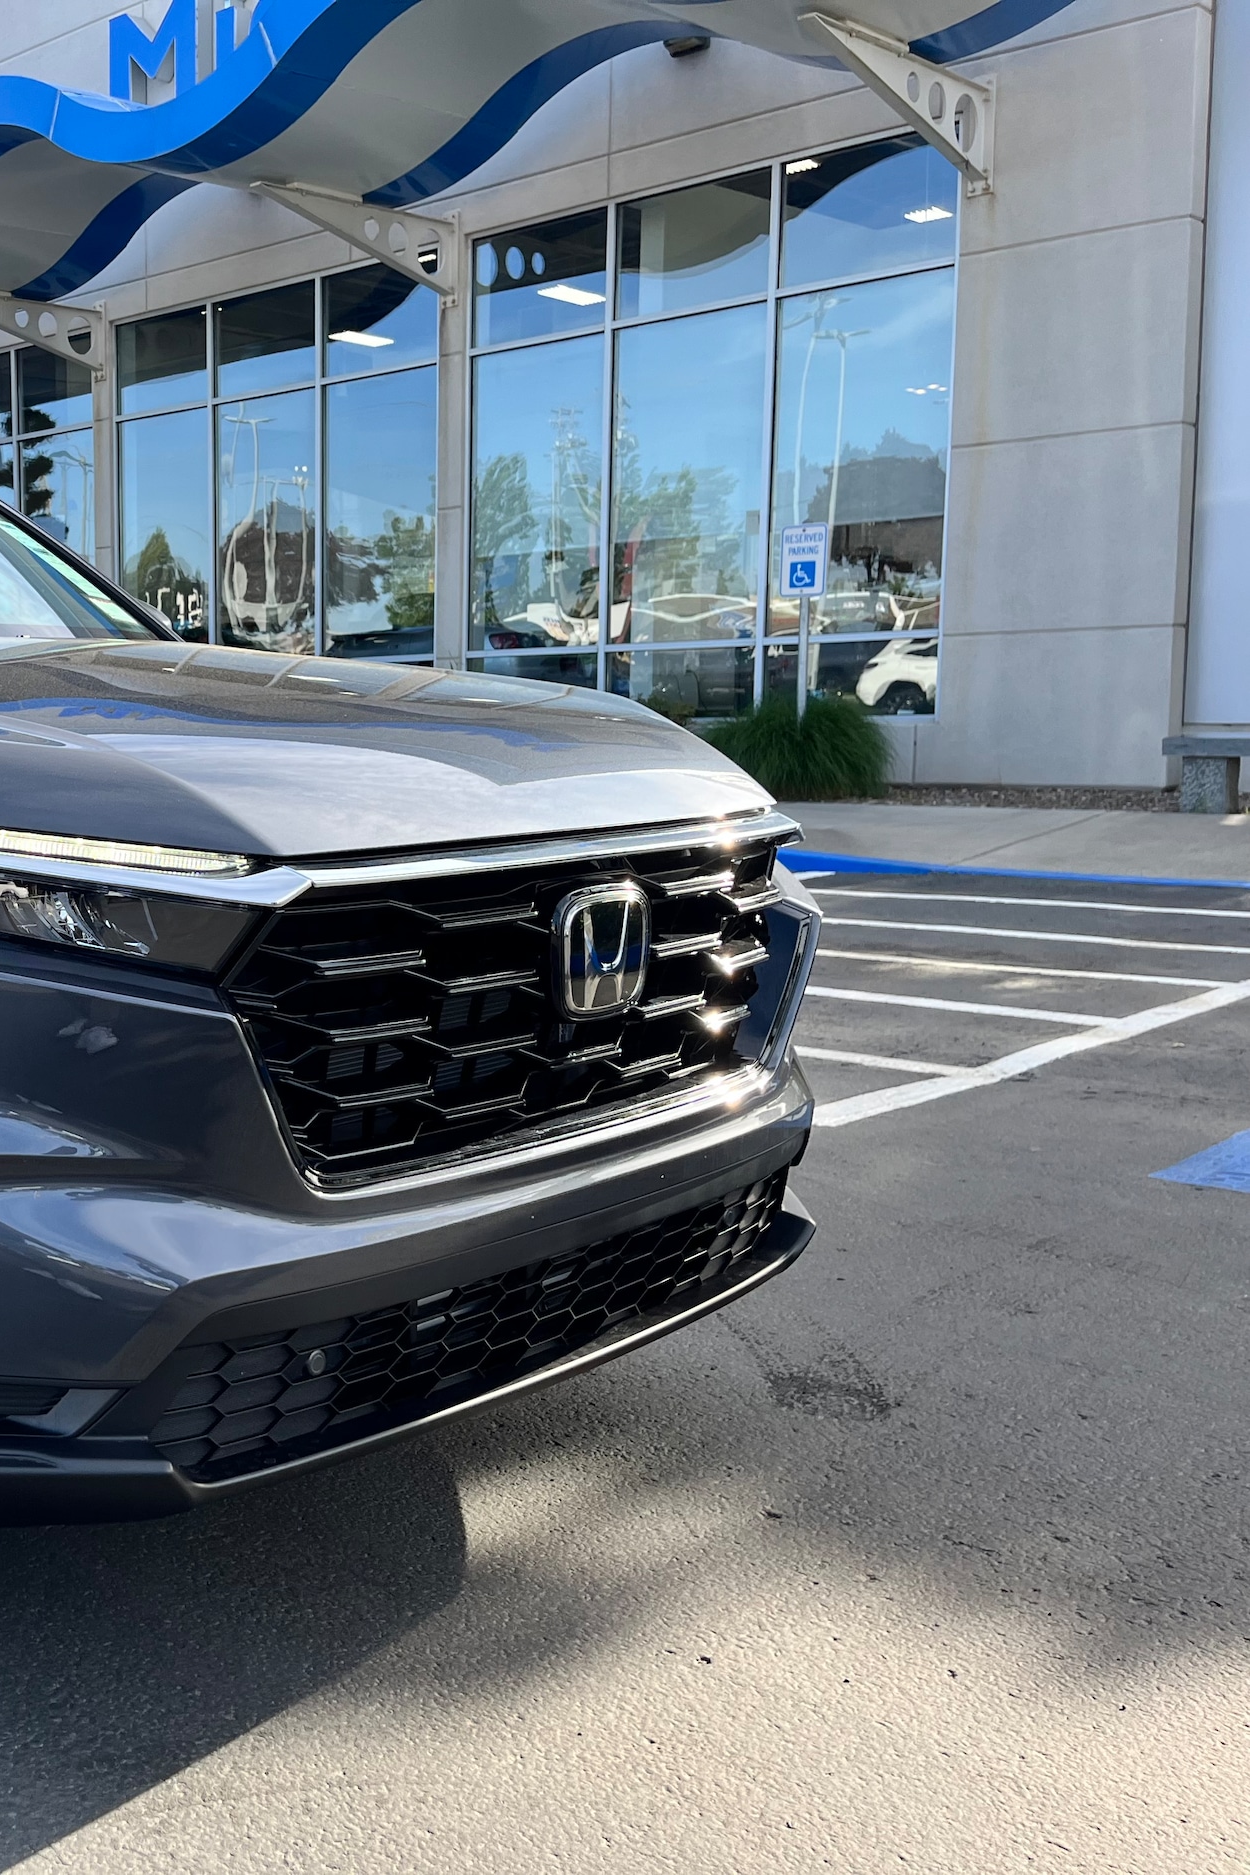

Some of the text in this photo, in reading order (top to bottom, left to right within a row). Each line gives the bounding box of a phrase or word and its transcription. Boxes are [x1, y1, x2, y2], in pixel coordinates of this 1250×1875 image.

[109, 0, 271, 102] MI
[785, 532, 824, 544] RESERVED
[788, 545, 819, 556] PARKING
